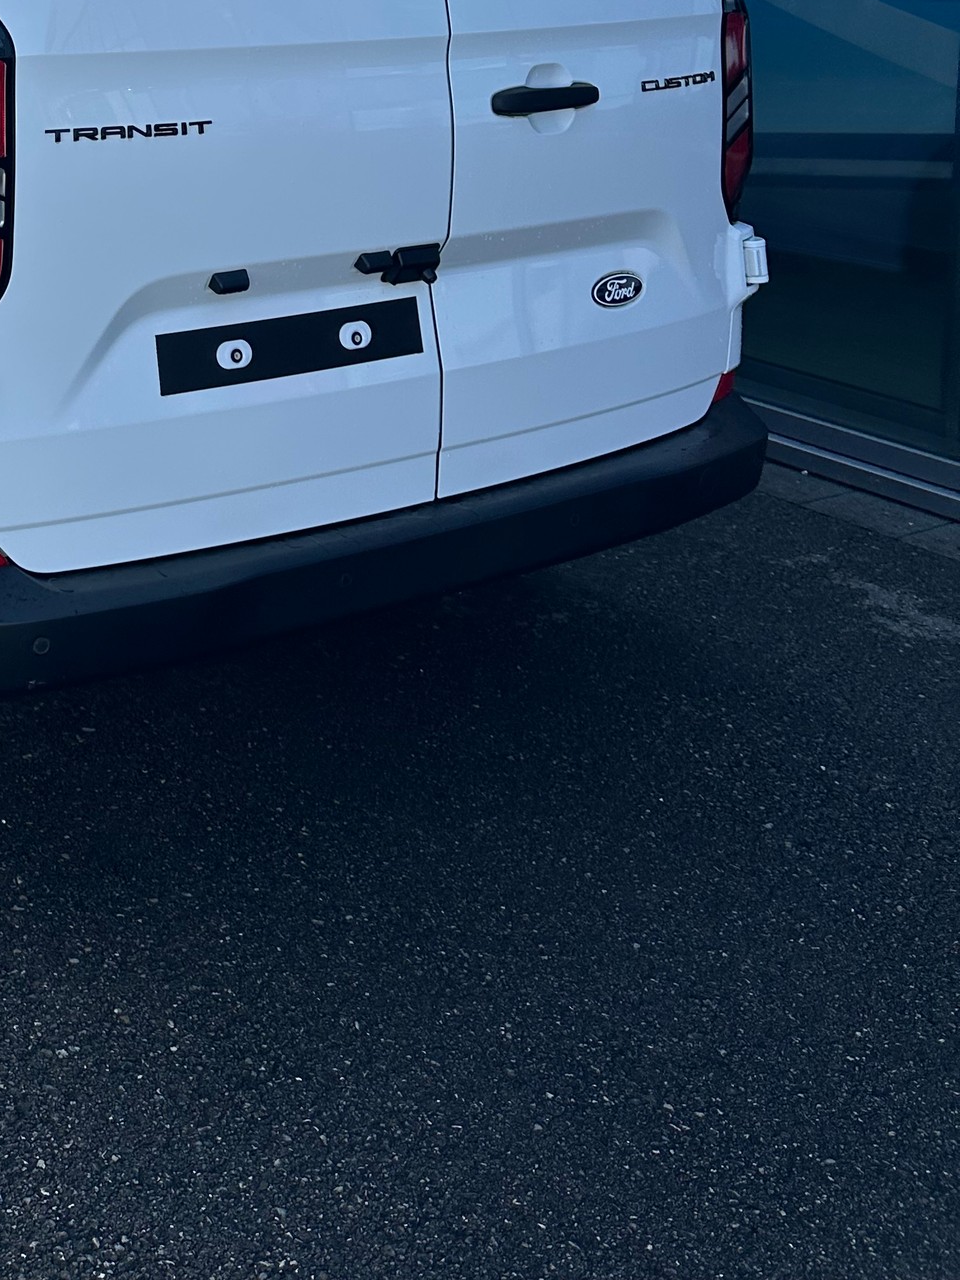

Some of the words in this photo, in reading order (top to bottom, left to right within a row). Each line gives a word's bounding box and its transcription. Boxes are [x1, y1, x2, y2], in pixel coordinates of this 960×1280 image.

[641, 71, 715, 92] CUSTOM
[45, 120, 213, 143] TRANSIT
[605, 279, 635, 302] Ford
